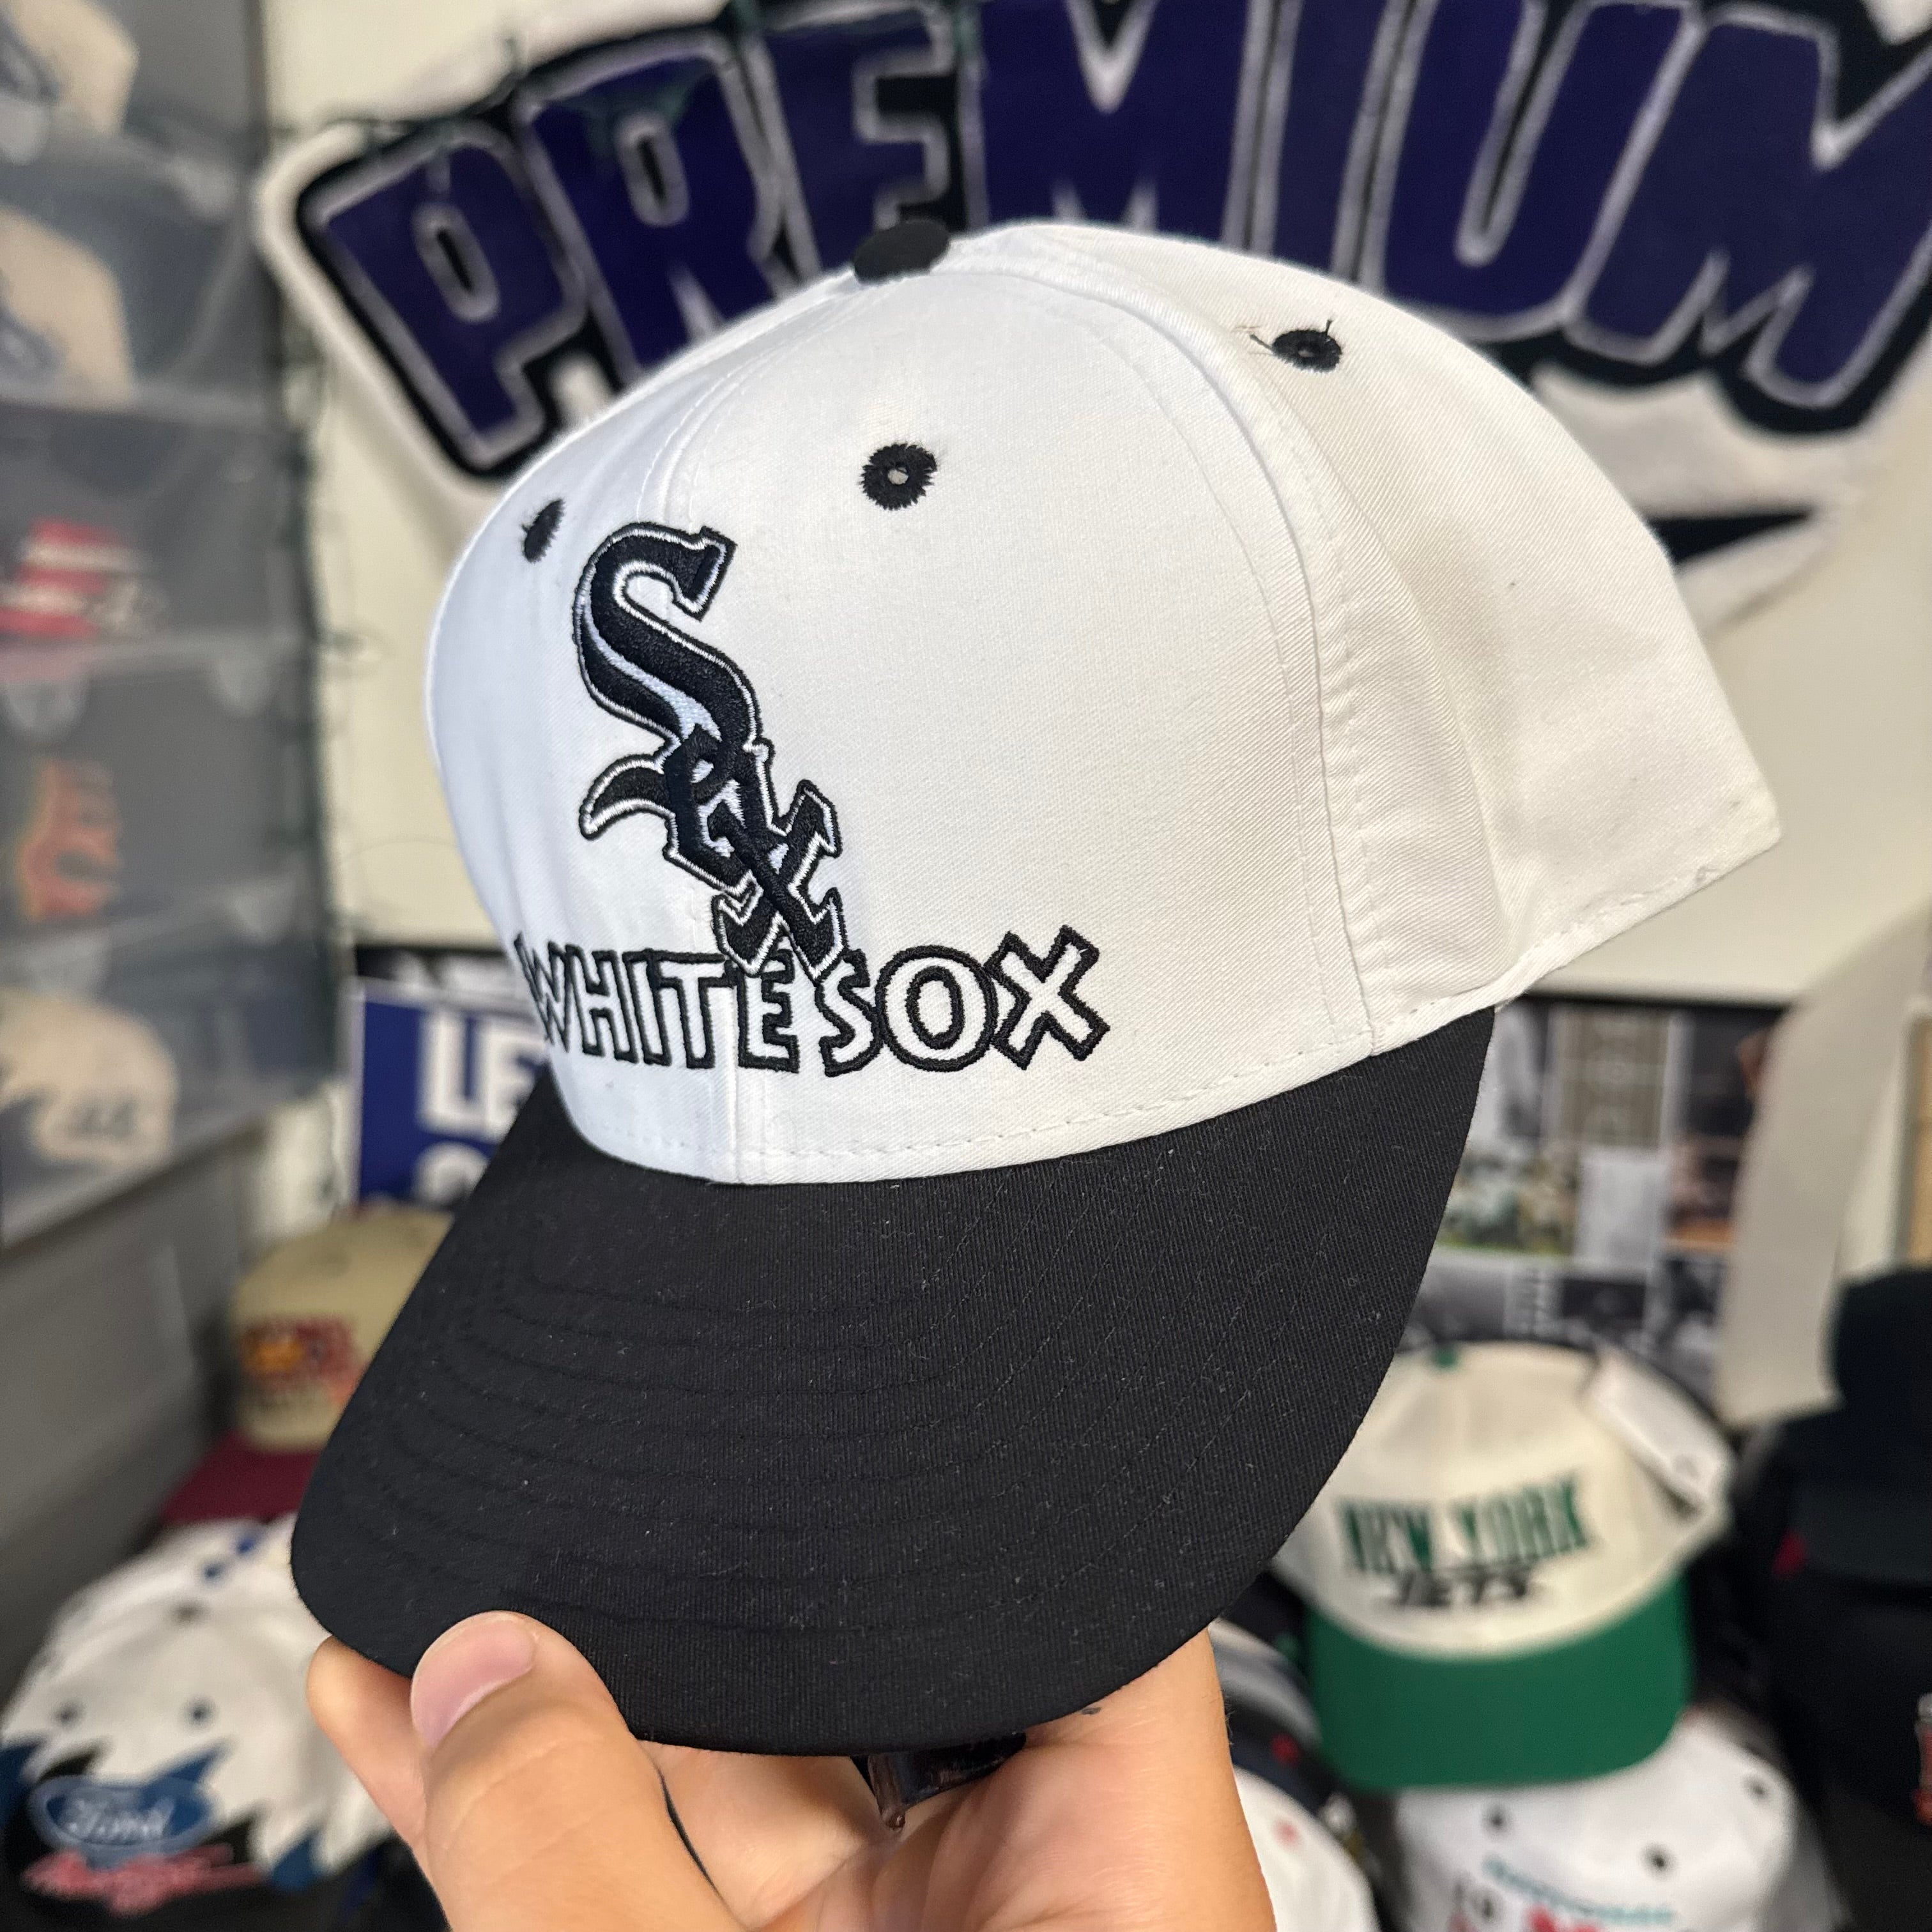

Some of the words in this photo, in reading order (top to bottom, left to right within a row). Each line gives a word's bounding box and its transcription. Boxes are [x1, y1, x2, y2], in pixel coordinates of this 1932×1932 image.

[308, 0, 1932, 471] PREMIUM
[513, 931, 800, 1073] WHITE
[818, 924, 1110, 1077] SOX
[1337, 1494, 1434, 1575] NEW
[1446, 1469, 1591, 1568] YORK
